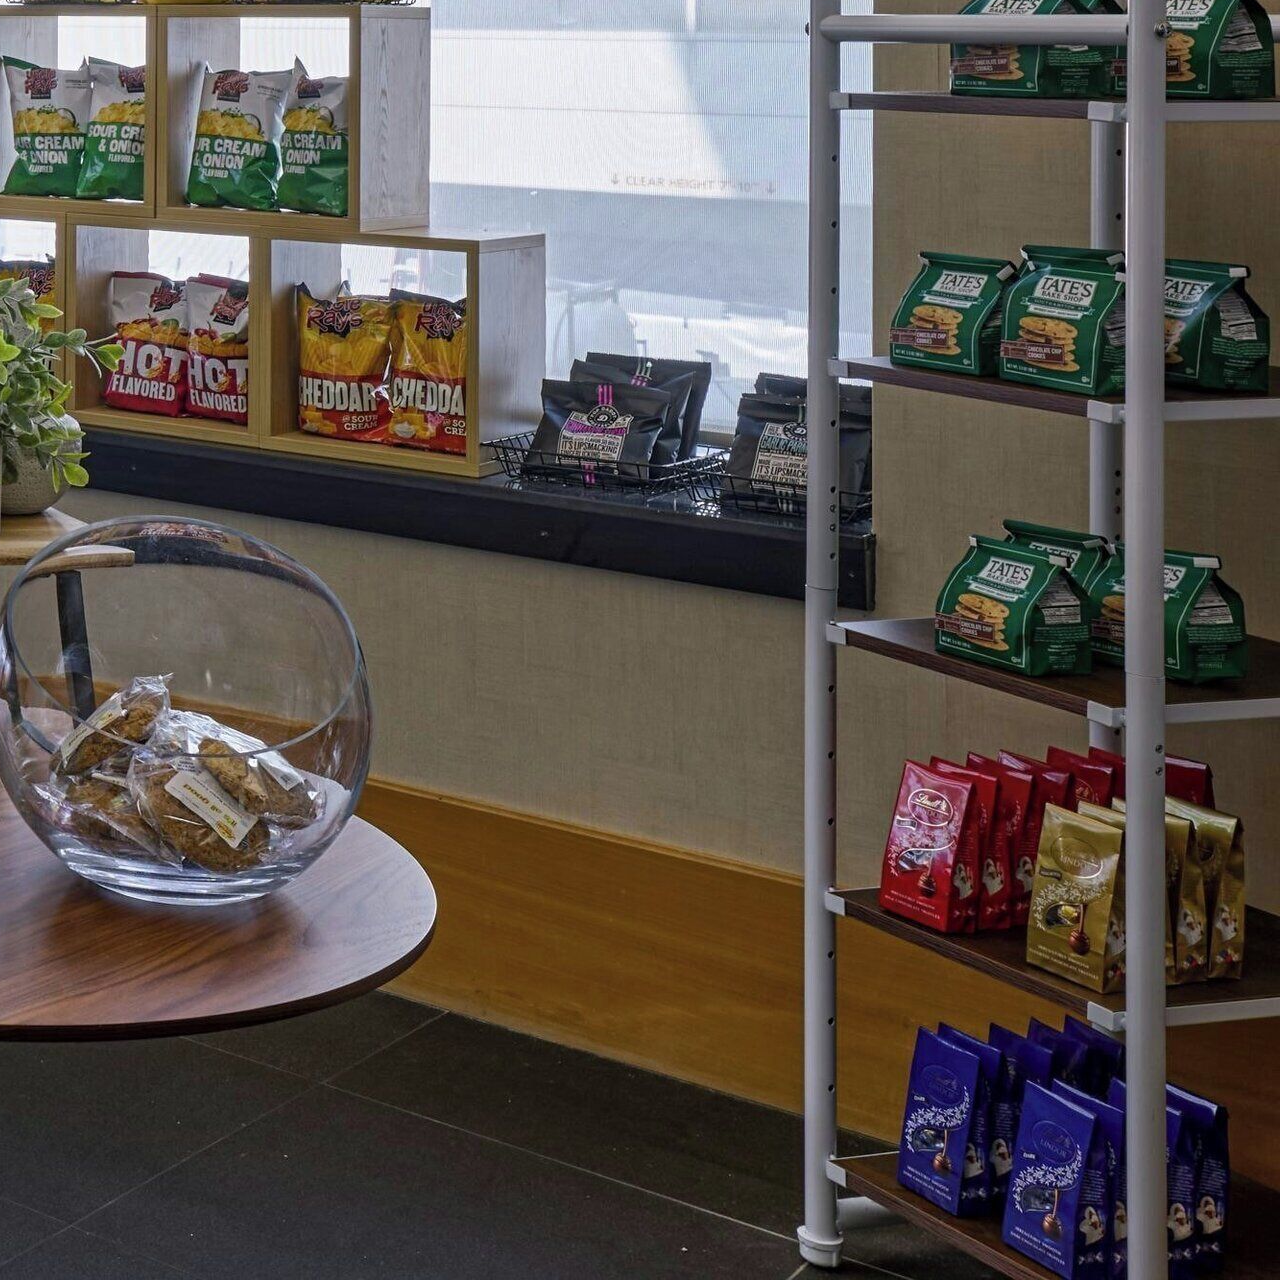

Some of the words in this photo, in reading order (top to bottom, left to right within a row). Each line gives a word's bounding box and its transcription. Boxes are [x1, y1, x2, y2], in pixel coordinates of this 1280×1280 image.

[88, 125, 117, 137] SOUR
[34, 136, 84, 150] CREAM
[98, 141, 106, 152] &
[214, 138, 267, 157] CREAM
[294, 134, 341, 150] CREAM
[30, 151, 68, 164] ONION
[108, 154, 135, 163] FLAVORED
[203, 153, 244, 169] ONION
[286, 149, 320, 164] ONION
[29, 165, 53, 173] FLAVORED
[625, 175, 664, 186] CLEAR
[669, 179, 714, 189] HEIGHT
[940, 272, 985, 291] TATE'S
[1042, 276, 1094, 298] TATE'S
[1041, 290, 1061, 300] BAKE
[1063, 292, 1084, 303] SHOP
[114, 340, 188, 384] HOT
[1028, 352, 1046, 360] COOKIES
[113, 376, 176, 402] FLAVORED
[344, 421, 377, 431] CREAM
[761, 435, 787, 449] GARLIC
[990, 559, 1032, 582] TATE'S
